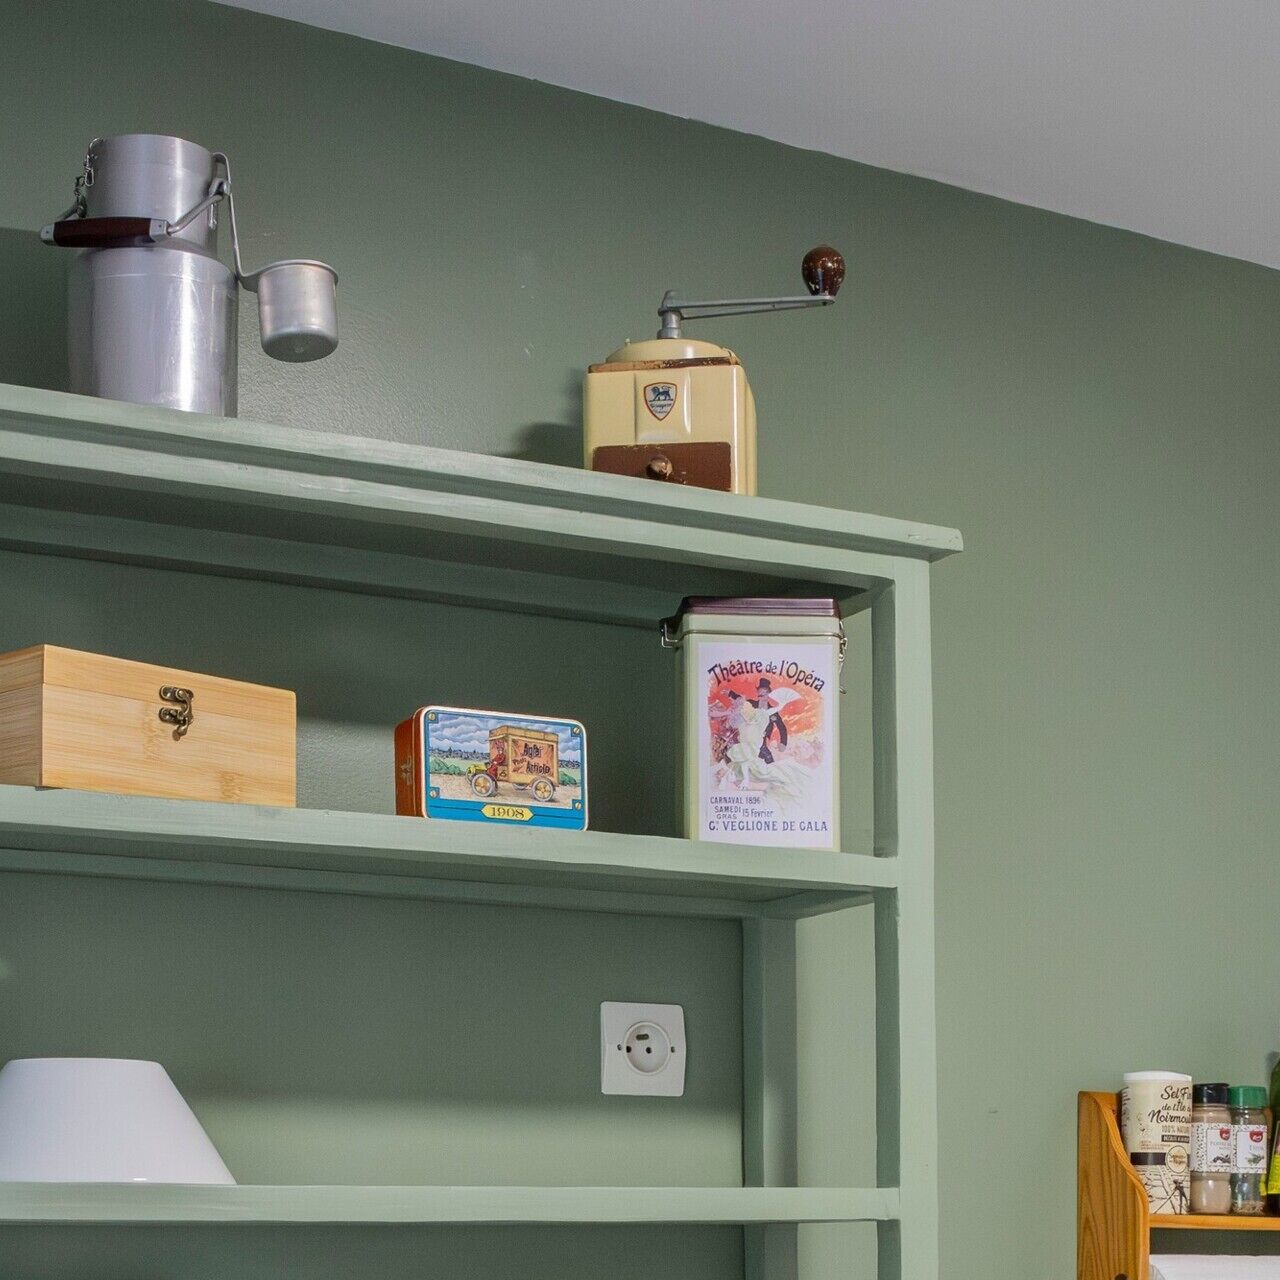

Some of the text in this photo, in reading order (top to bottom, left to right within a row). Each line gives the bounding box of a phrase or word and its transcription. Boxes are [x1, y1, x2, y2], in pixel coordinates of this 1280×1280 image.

[707, 659, 825, 692] Théâtre de l'Opéra
[710, 796, 743, 804] CARNAVAL
[491, 806, 525, 819] 1908
[714, 805, 741, 813] SAMEDI
[722, 821, 778, 831] VEGLIONE
[782, 821, 795, 831] DE
[799, 821, 828, 831] GALA
[1160, 1084, 1179, 1100] Sel
